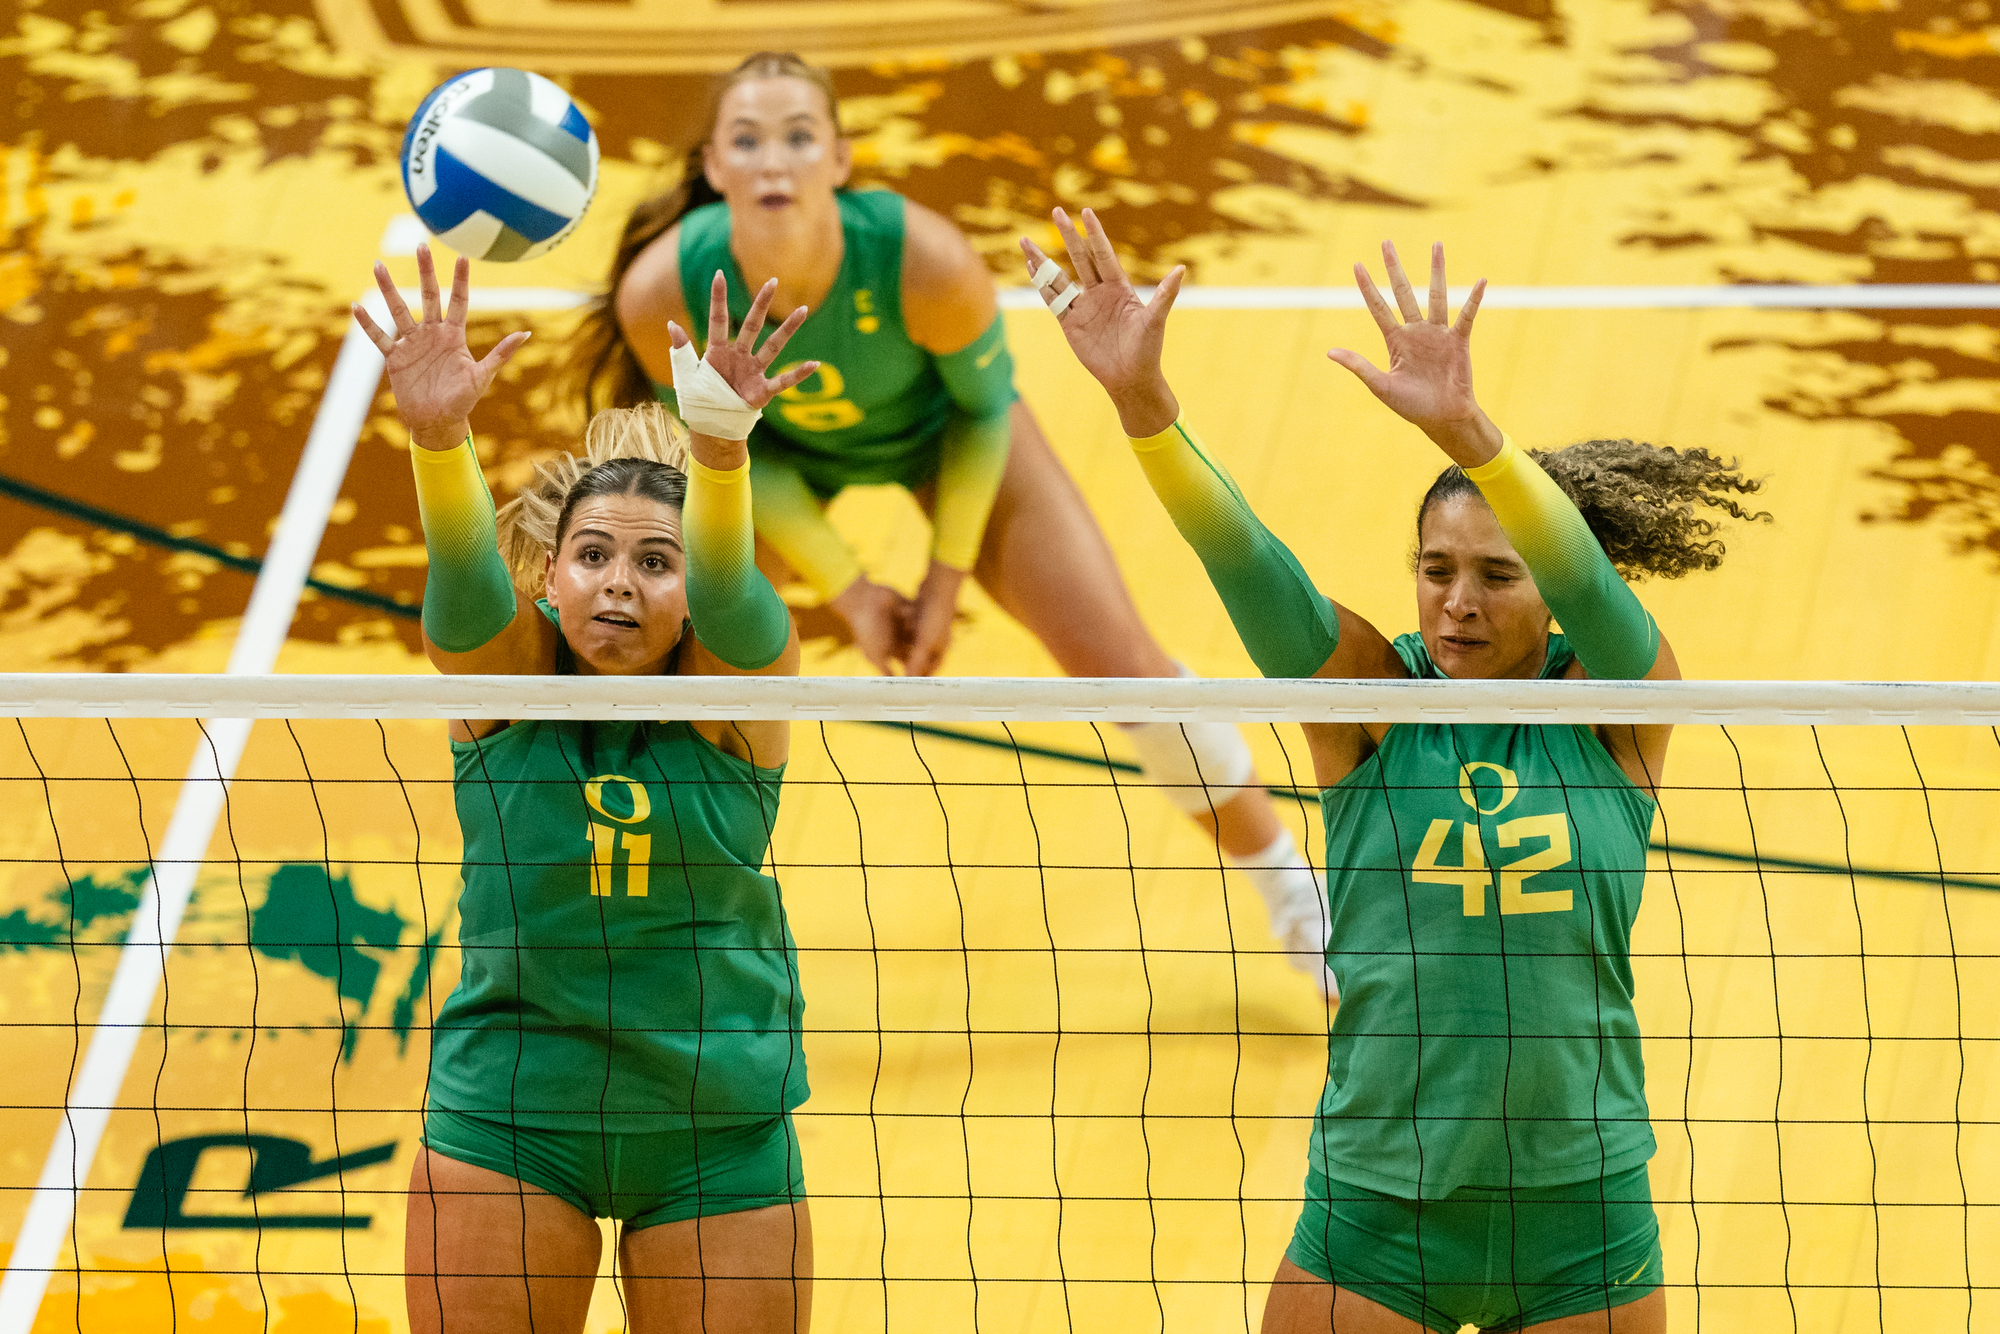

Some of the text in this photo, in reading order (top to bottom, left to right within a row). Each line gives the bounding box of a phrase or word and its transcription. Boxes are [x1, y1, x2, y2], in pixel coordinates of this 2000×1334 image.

[412, 82, 470, 175] molten
[585, 821, 651, 897] 11
[1412, 812, 1573, 916] 42
